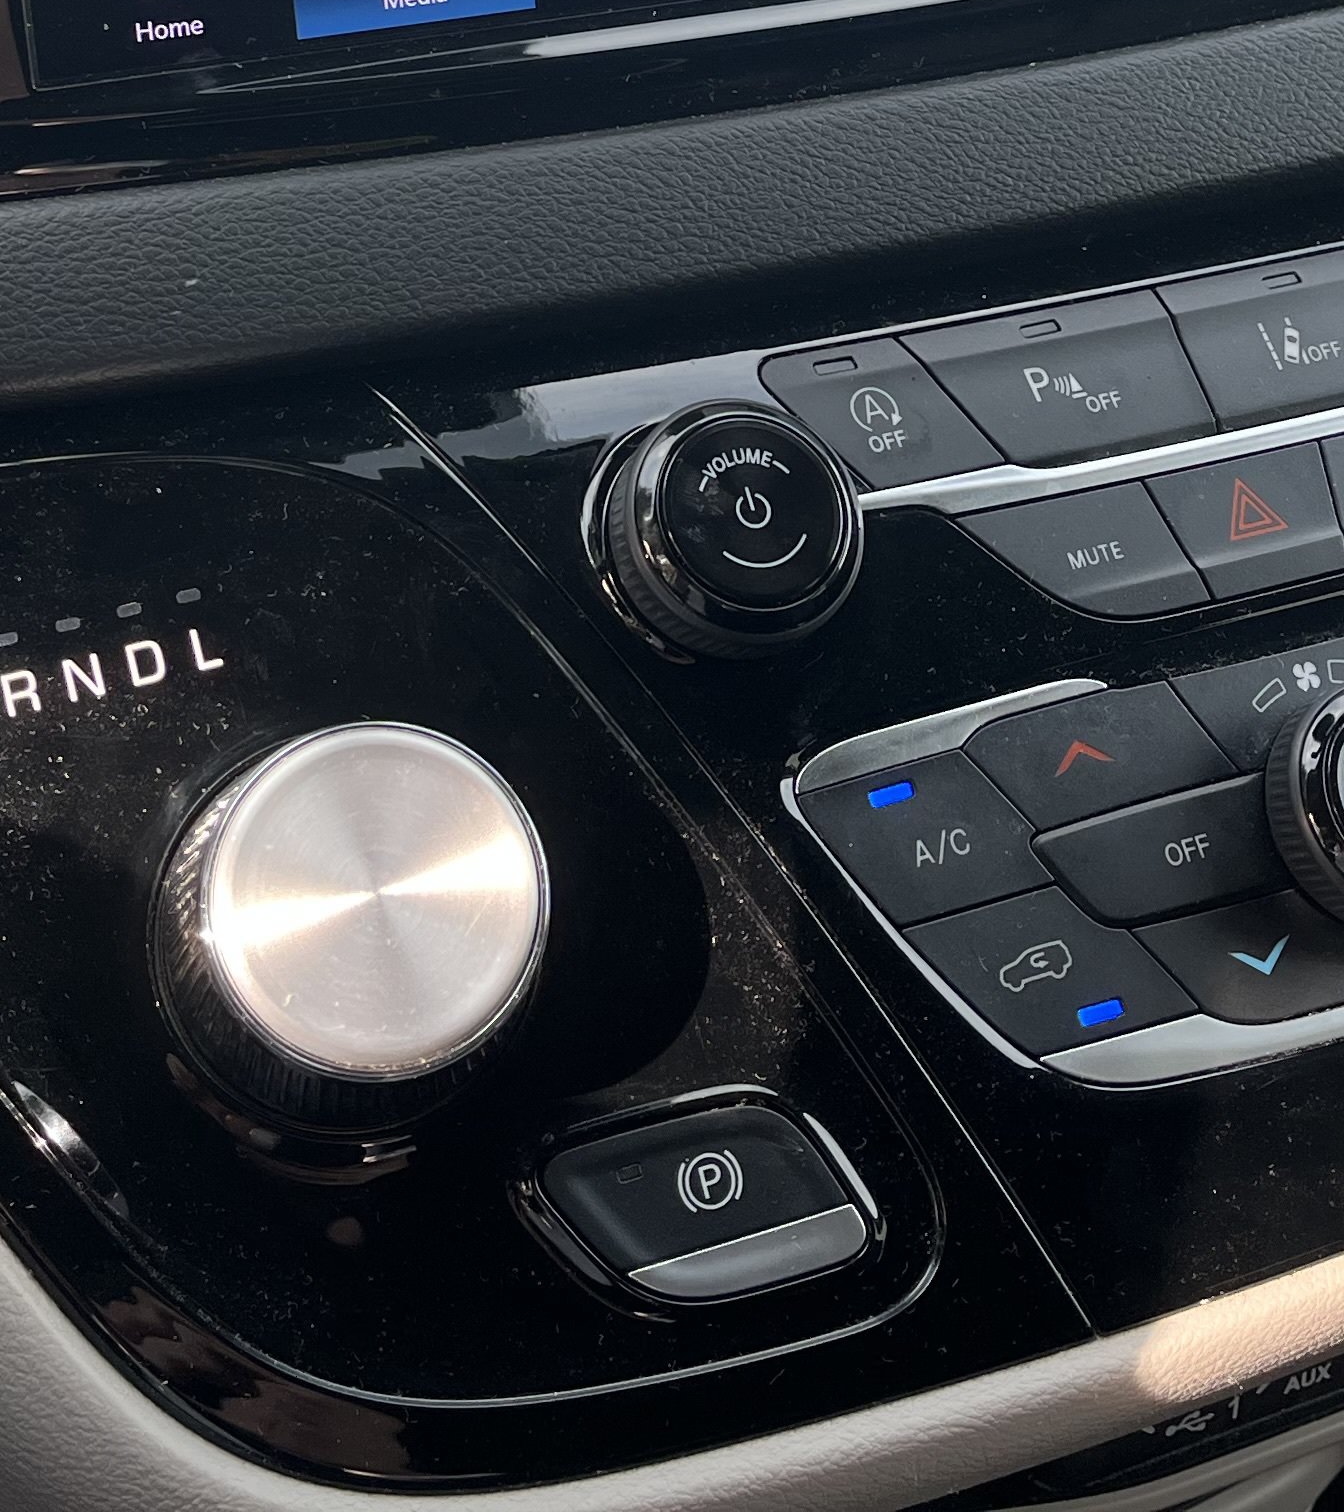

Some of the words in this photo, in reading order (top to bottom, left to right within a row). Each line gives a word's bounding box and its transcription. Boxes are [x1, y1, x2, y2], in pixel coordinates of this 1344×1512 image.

[135, 16, 204, 42] Home
[1307, 340, 1342, 364] OFF
[1085, 389, 1122, 414] OFF
[868, 429, 907, 454] OFF
[702, 448, 774, 481] VOLUME
[1067, 541, 1126, 570] MUTE
[915, 828, 971, 867] A/C
[1164, 833, 1211, 866] OFF
[1284, 1362, 1332, 1395] AUX
